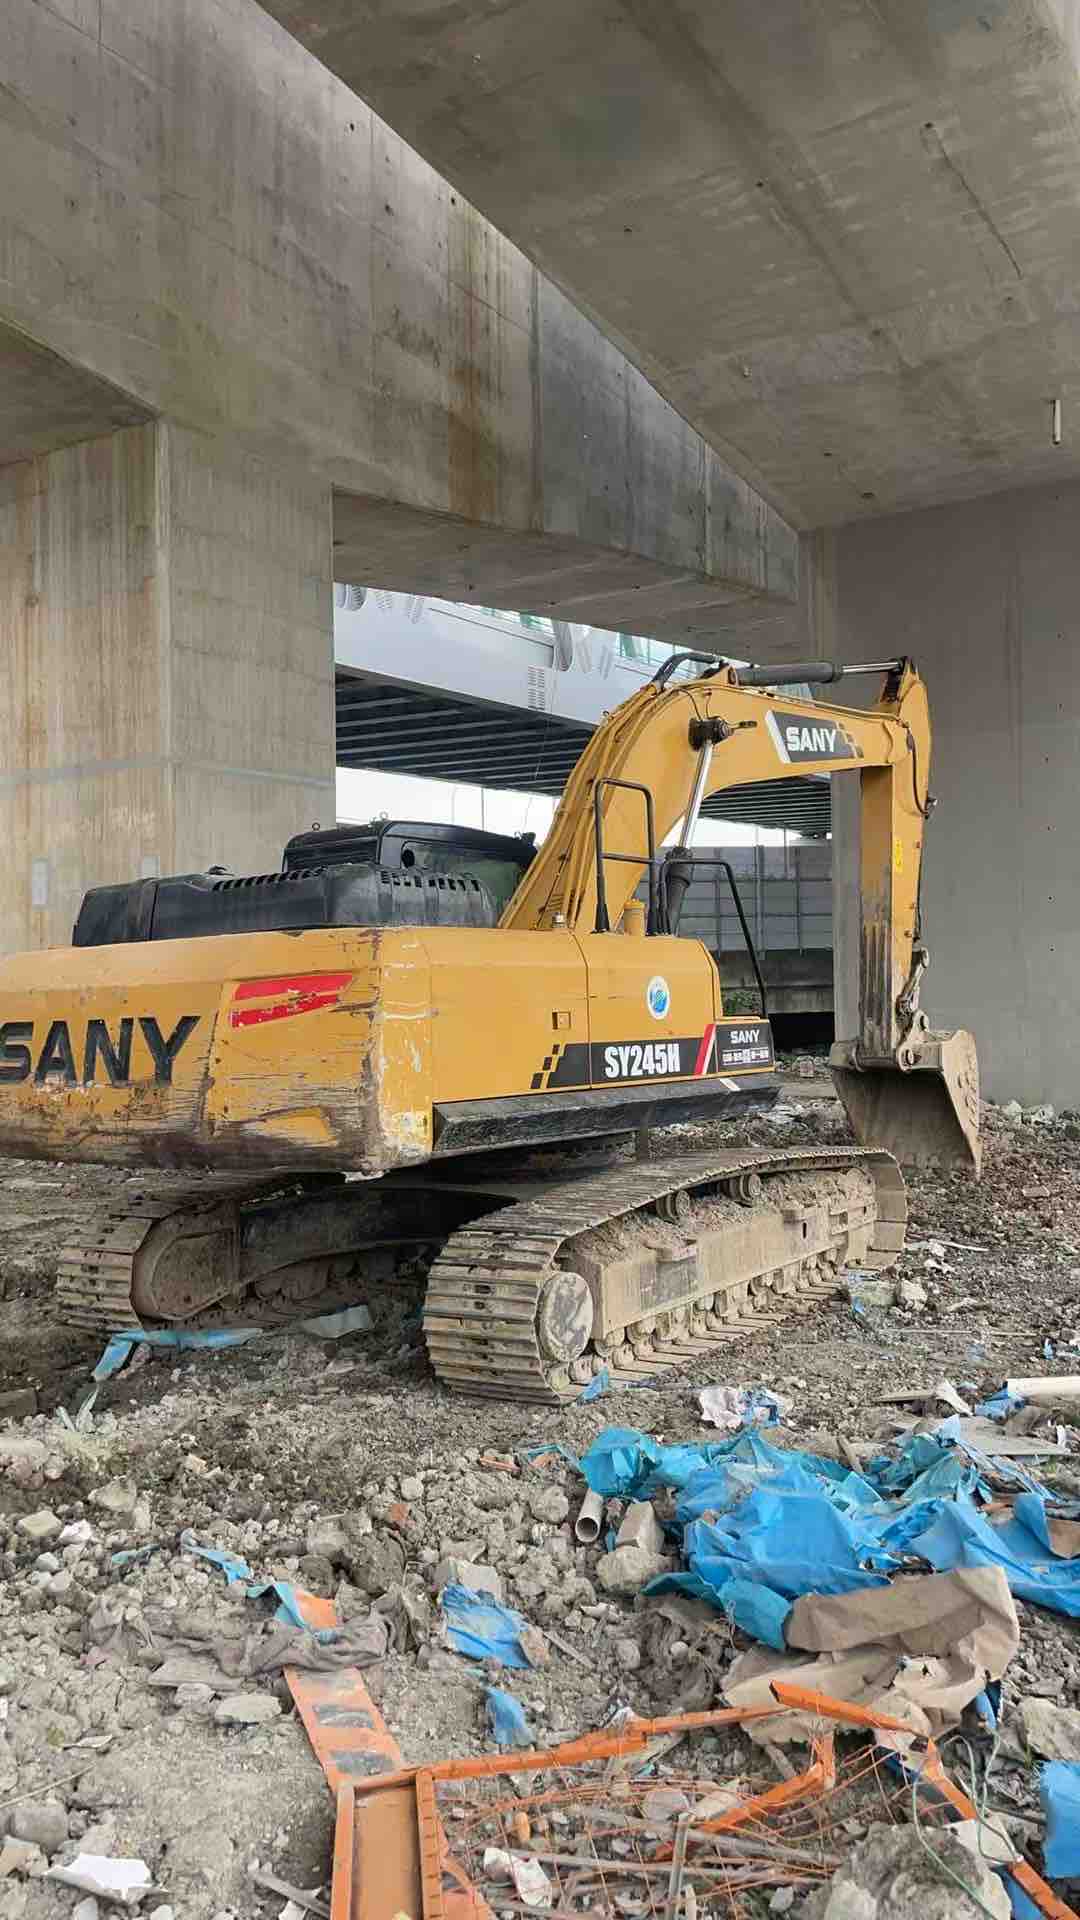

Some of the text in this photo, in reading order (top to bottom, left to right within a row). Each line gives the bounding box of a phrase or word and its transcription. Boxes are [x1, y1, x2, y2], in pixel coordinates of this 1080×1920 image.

[786, 726, 836, 752] SANY
[730, 1029, 760, 1044] SANY
[0, 1016, 202, 1088] SANY
[605, 1043, 680, 1078] SY245H
